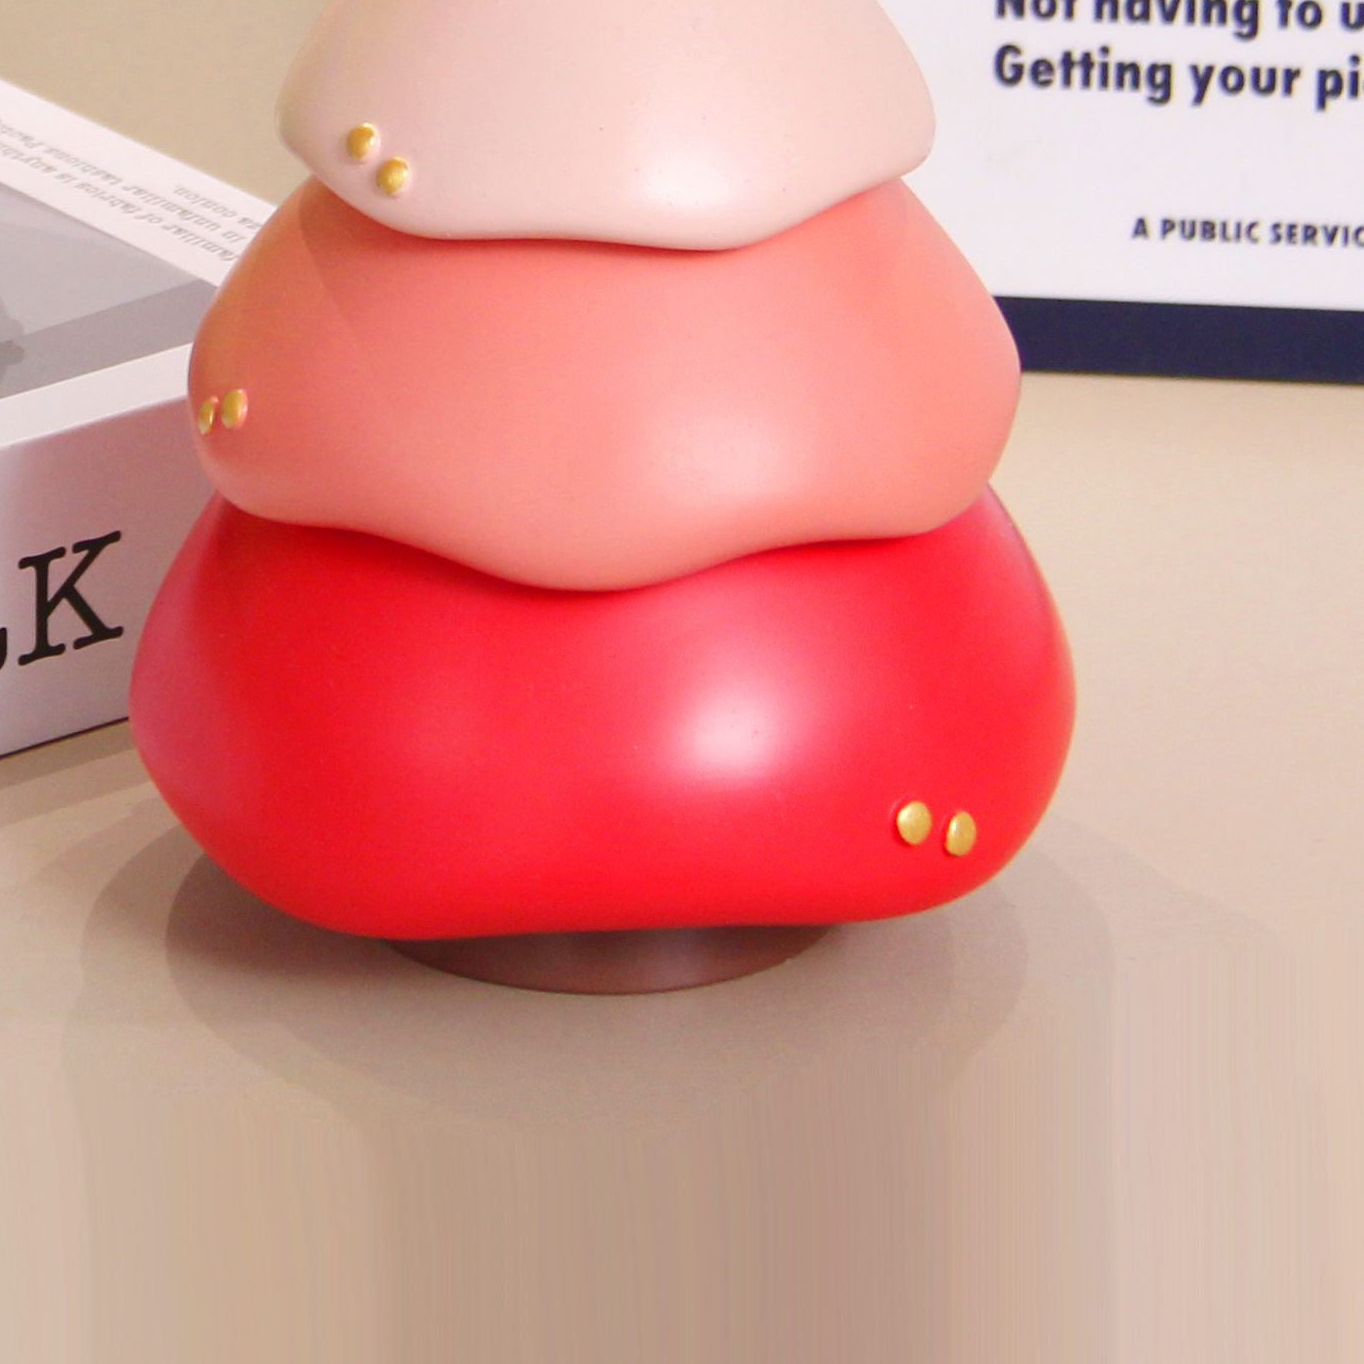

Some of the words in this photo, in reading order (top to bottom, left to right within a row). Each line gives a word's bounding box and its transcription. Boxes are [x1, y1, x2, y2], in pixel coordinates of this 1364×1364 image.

[994, 44, 1172, 106] Getting
[1190, 64, 1301, 105] your
[1131, 217, 1150, 239] A
[1160, 218, 1259, 244] PUBLIC
[1269, 222, 1364, 248] SERVIC
